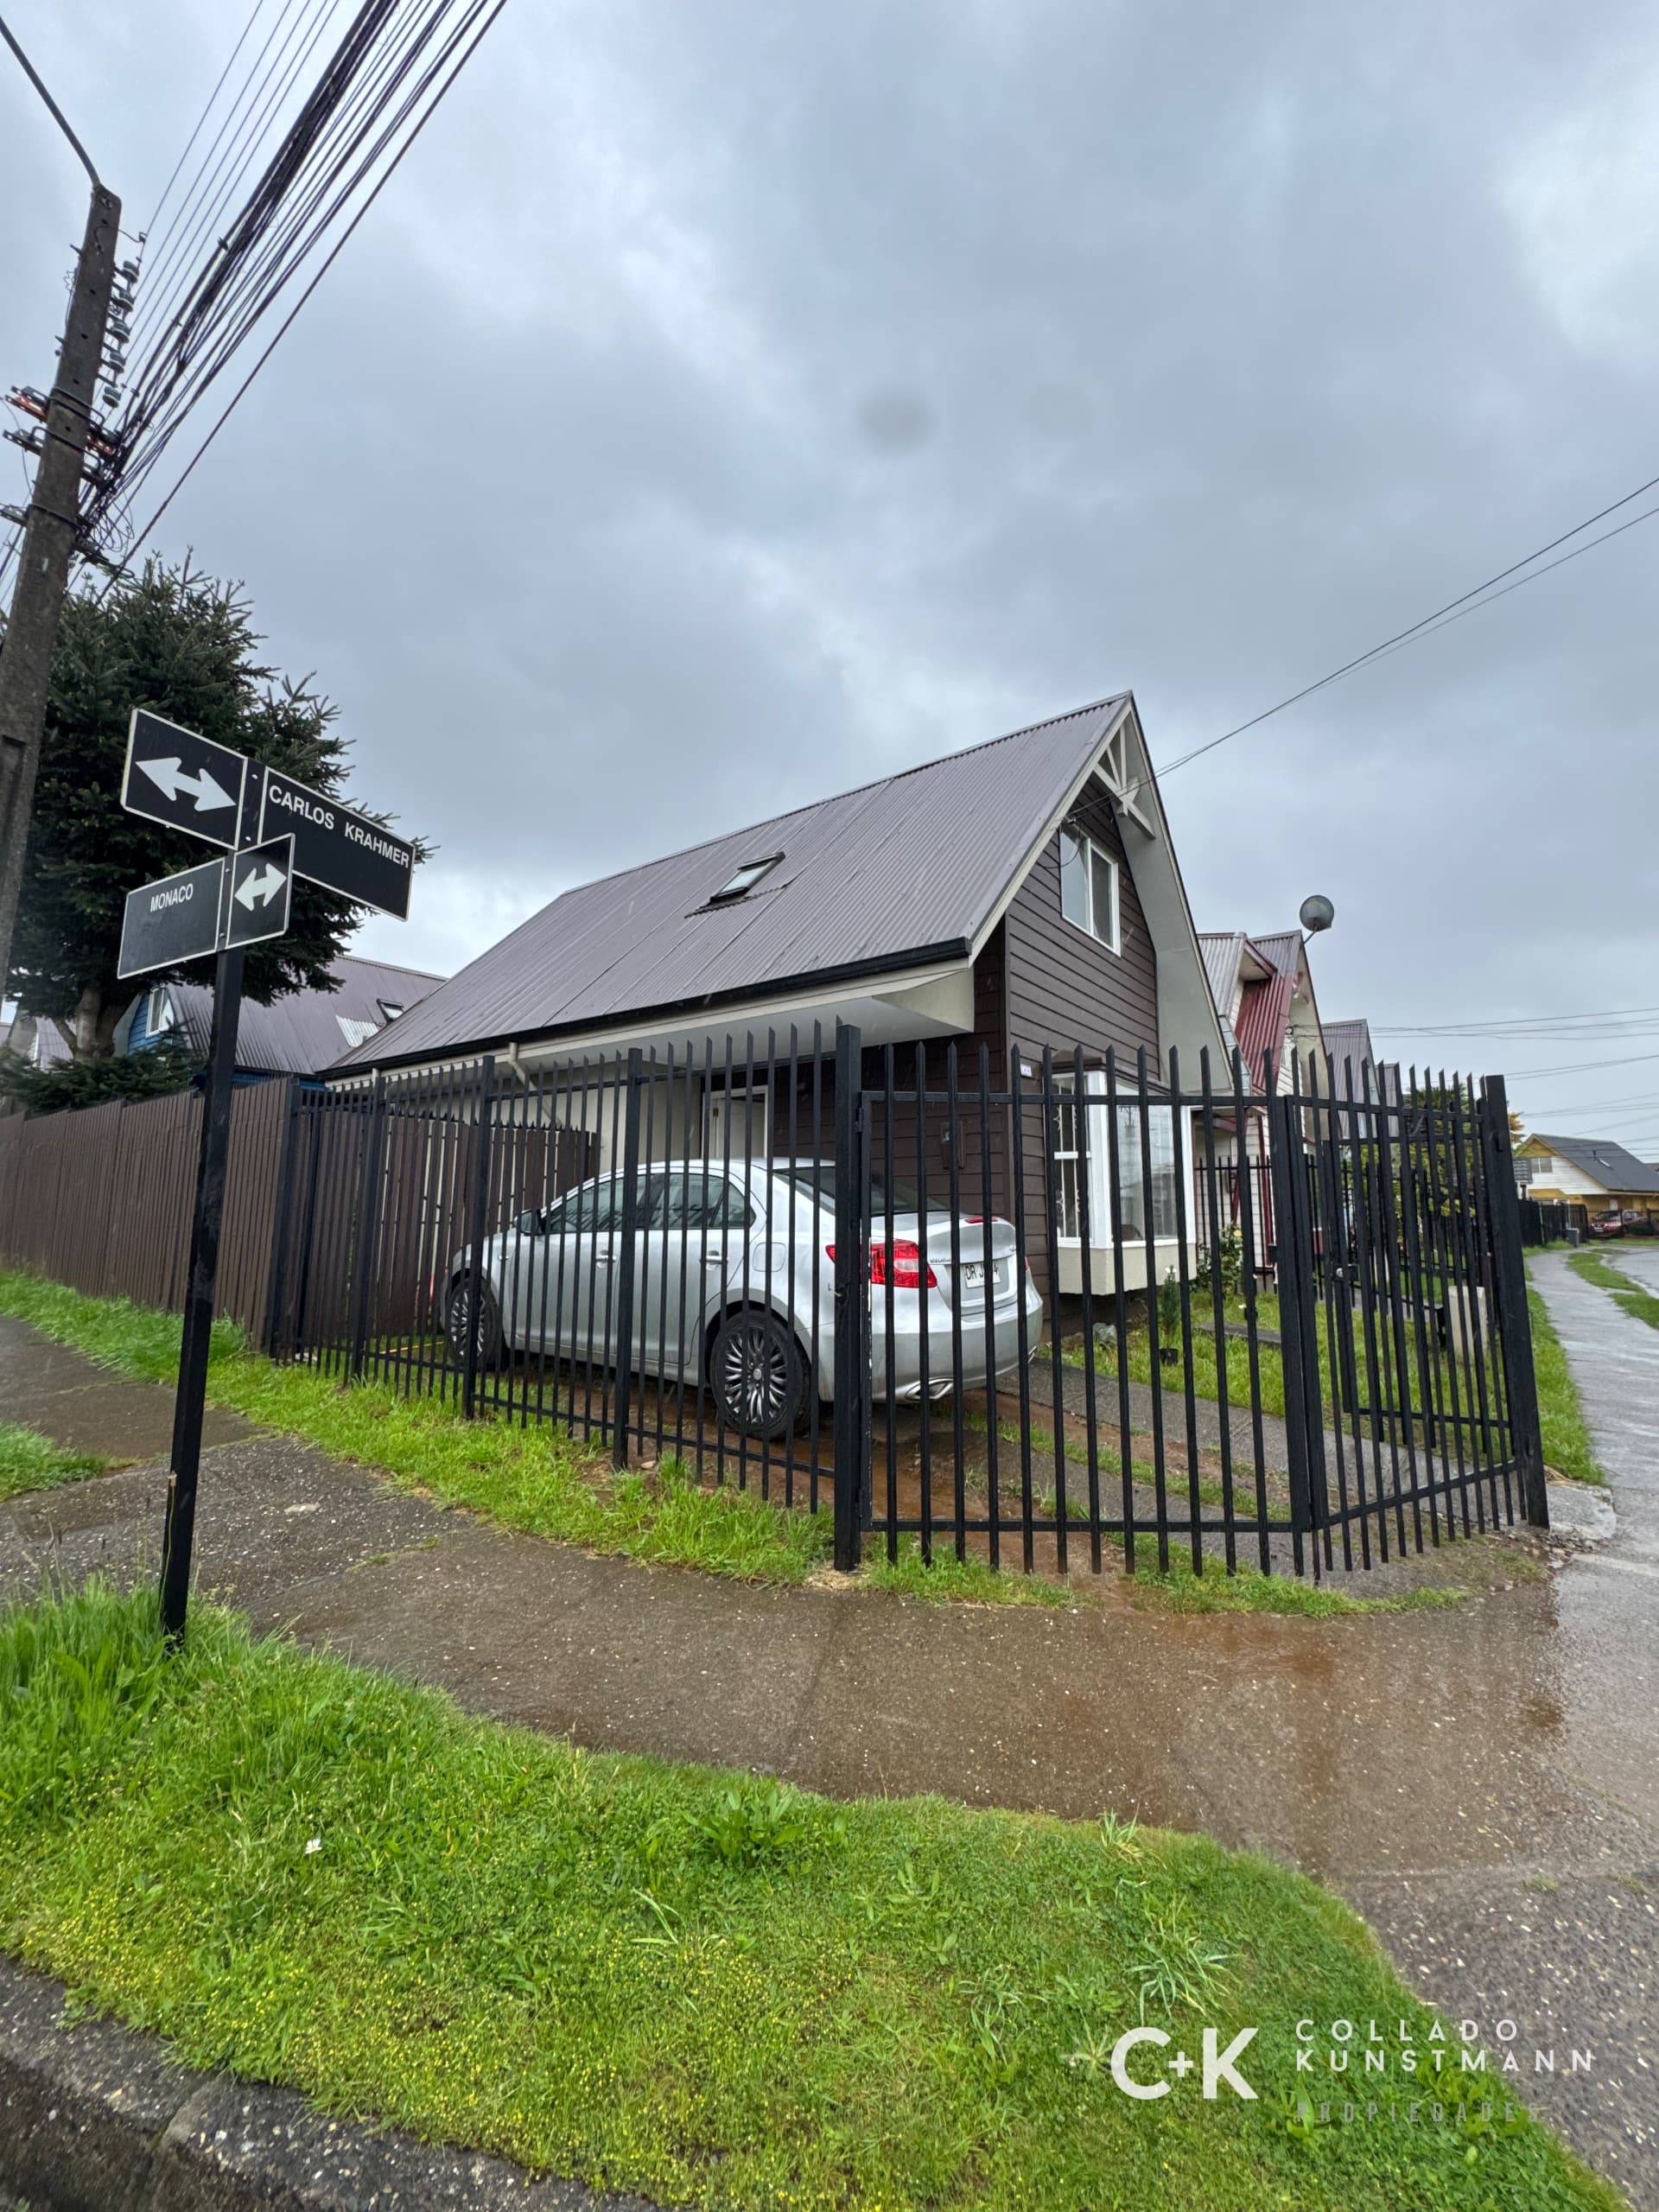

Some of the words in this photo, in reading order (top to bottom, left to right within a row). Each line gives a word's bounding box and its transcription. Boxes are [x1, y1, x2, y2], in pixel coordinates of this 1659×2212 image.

[268, 784, 335, 830] CARLOS
[344, 821, 410, 869] KRAHMER
[149, 882, 194, 913] MONACO
